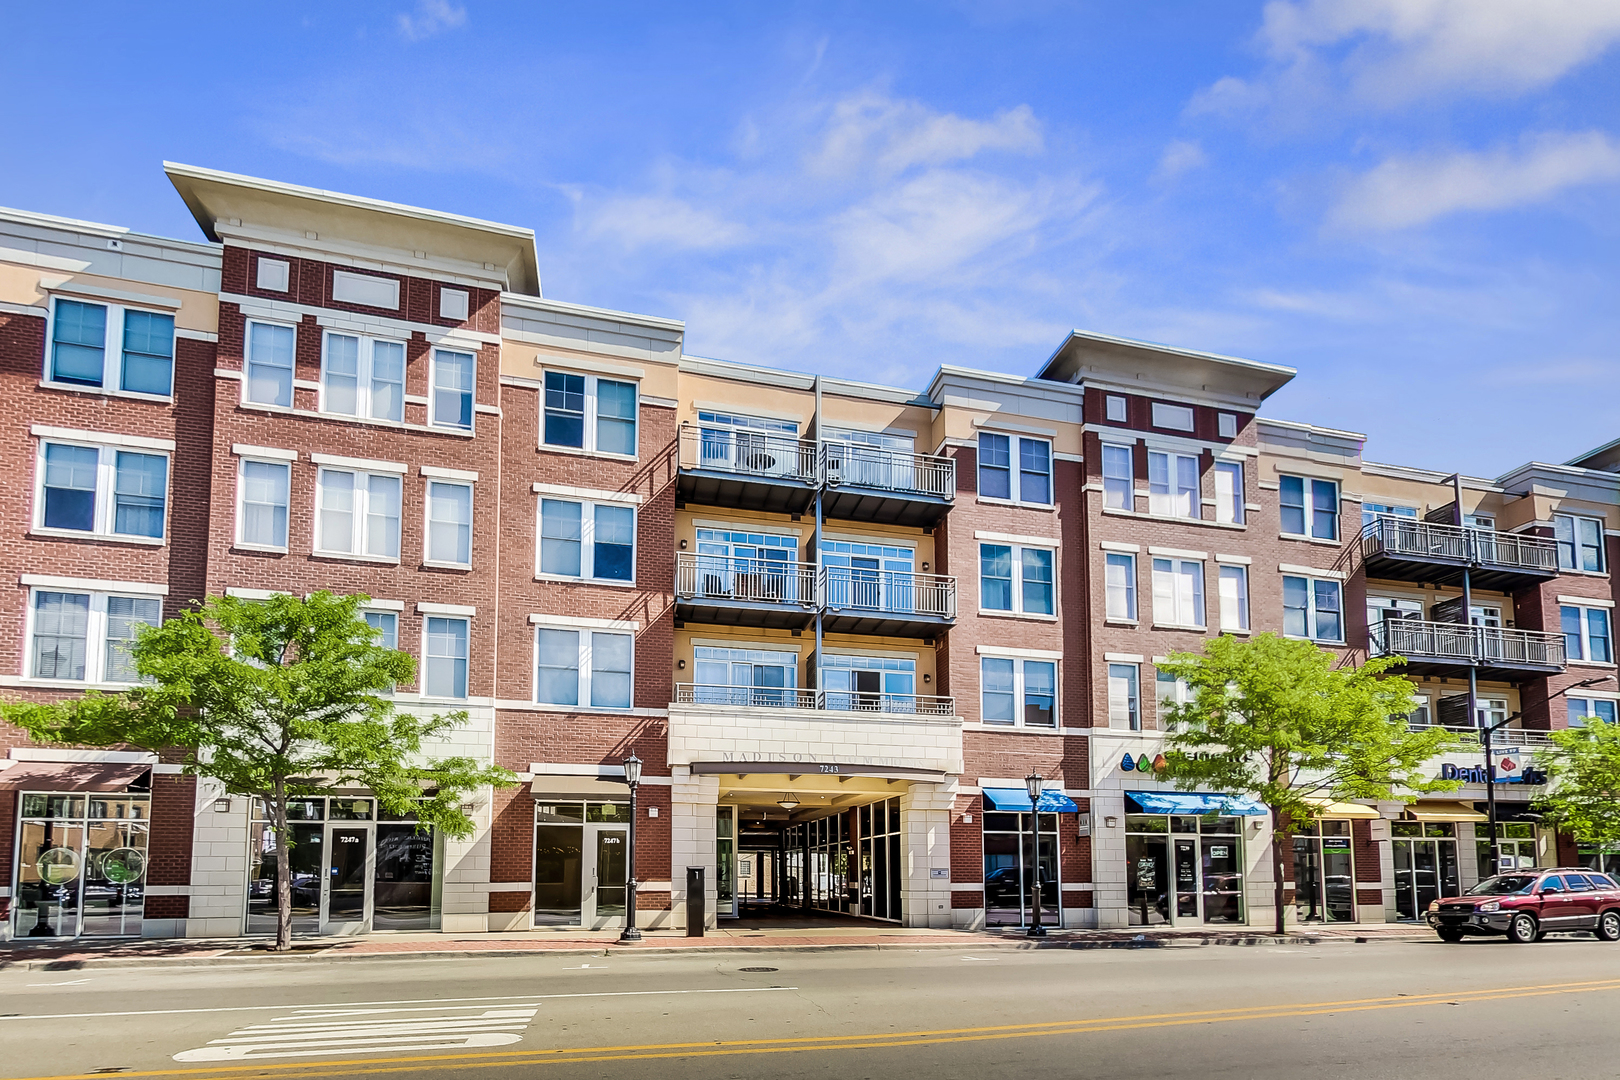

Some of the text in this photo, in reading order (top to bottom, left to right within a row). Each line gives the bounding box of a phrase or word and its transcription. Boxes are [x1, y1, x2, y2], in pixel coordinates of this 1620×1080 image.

[722, 752, 818, 763] MADISON
[819, 765, 839, 774] 7243
[1442, 763, 1548, 784] Dentalrks
